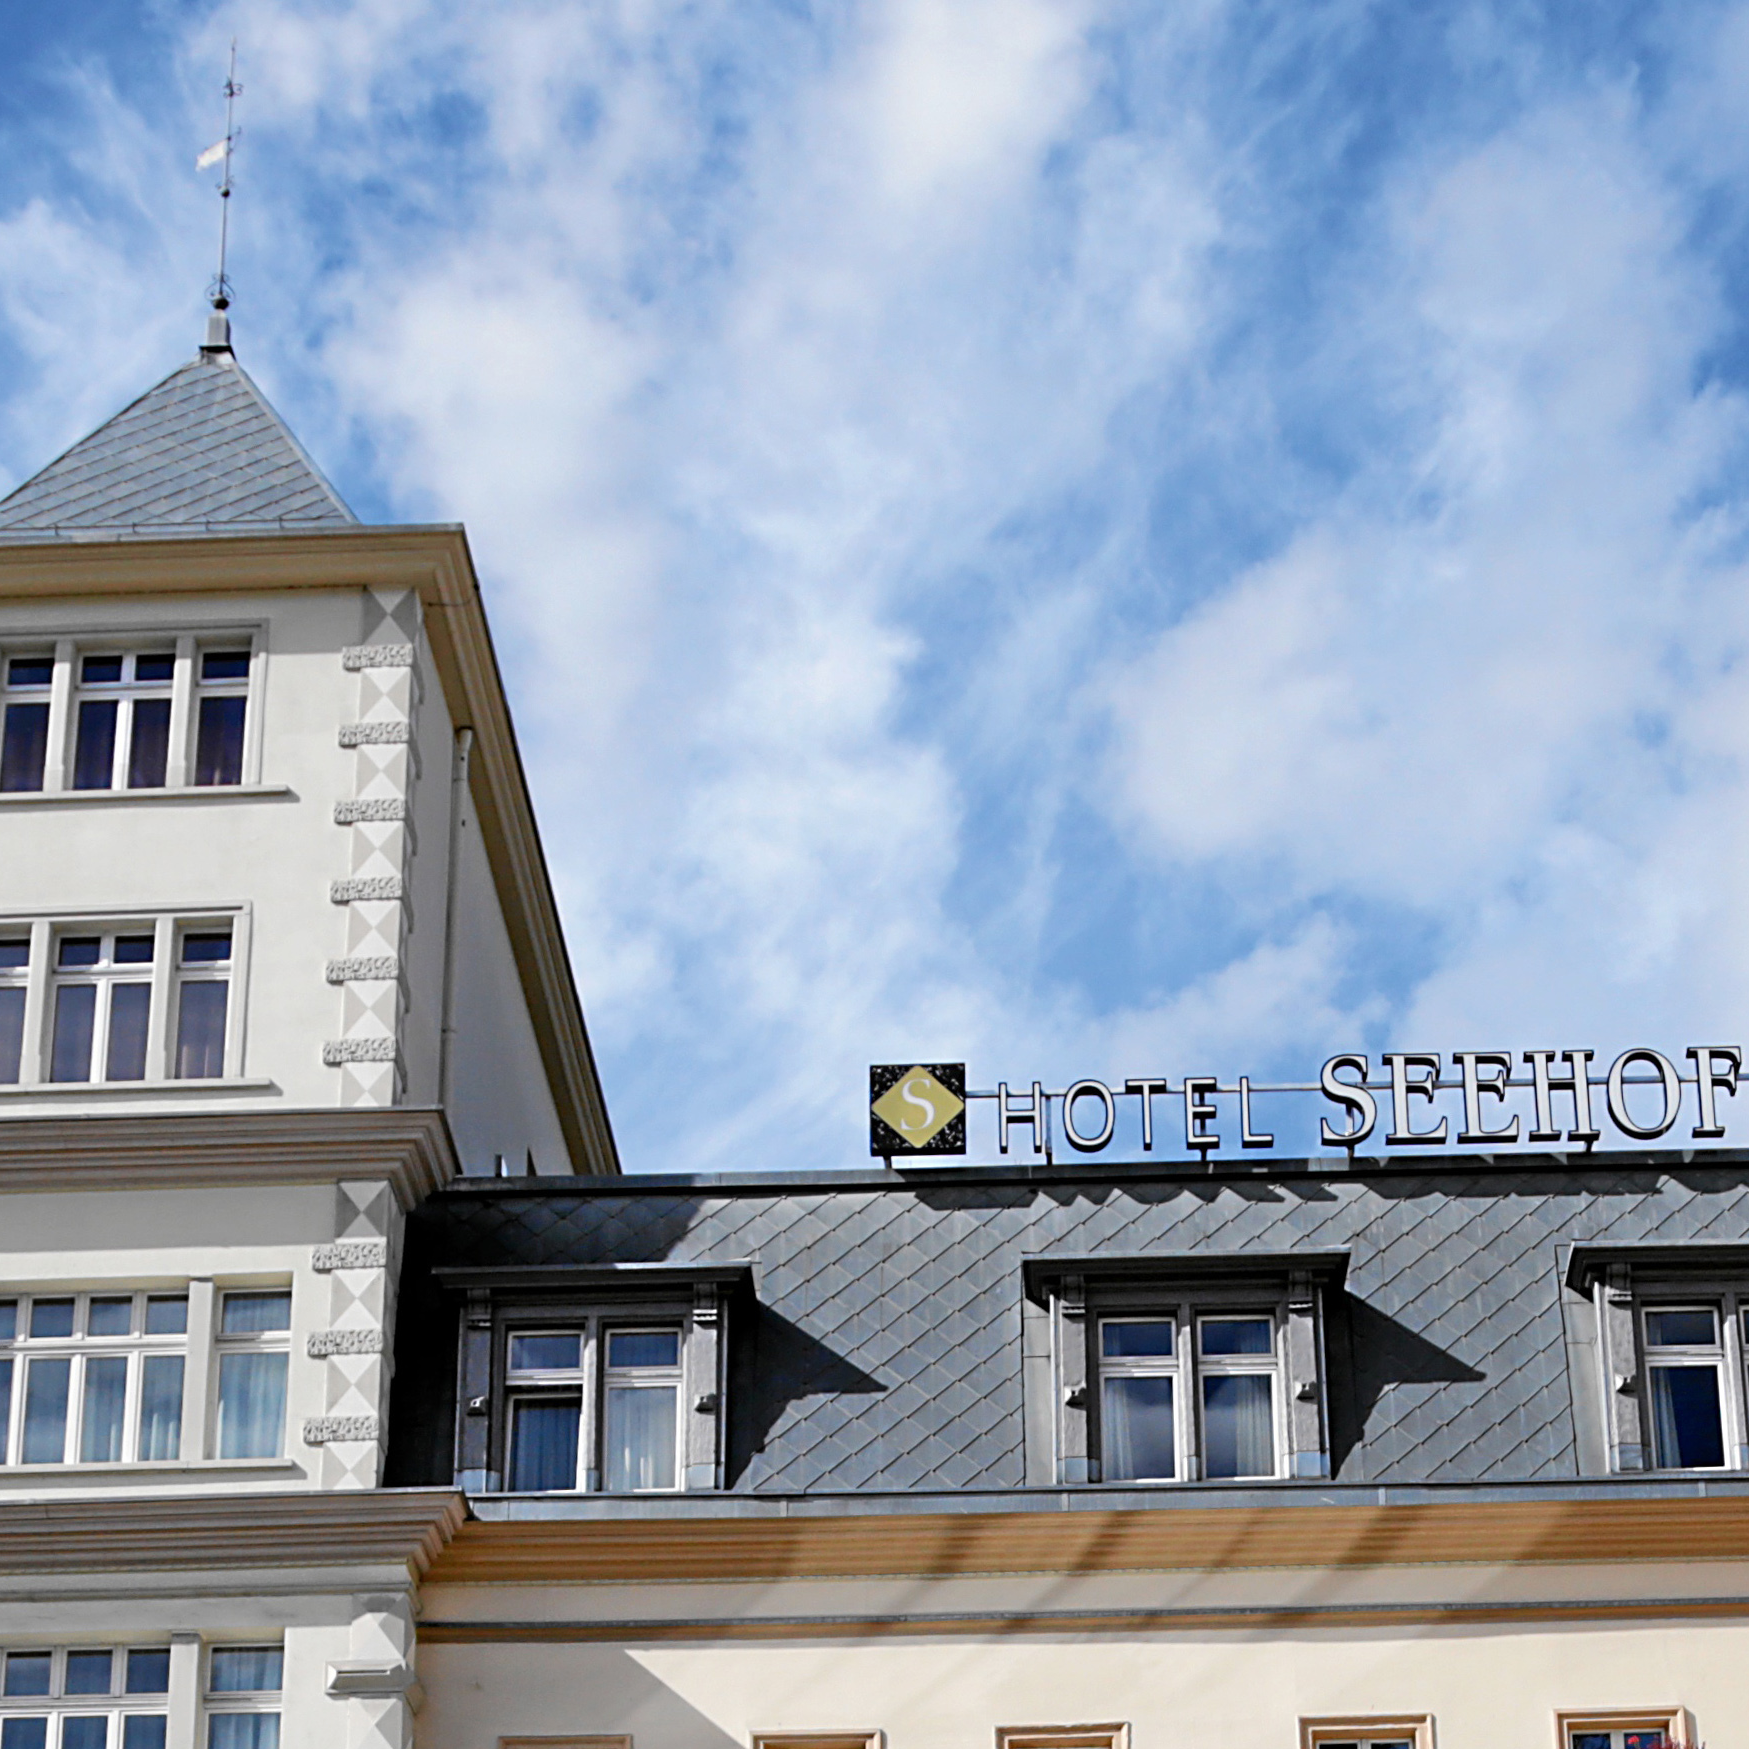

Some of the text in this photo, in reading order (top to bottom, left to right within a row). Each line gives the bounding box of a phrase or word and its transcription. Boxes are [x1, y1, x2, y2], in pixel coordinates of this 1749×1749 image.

[901, 1077, 935, 1131] S
[998, 1076, 1274, 1153] HOTEL
[1320, 1046, 1742, 1147] SEEHOF
